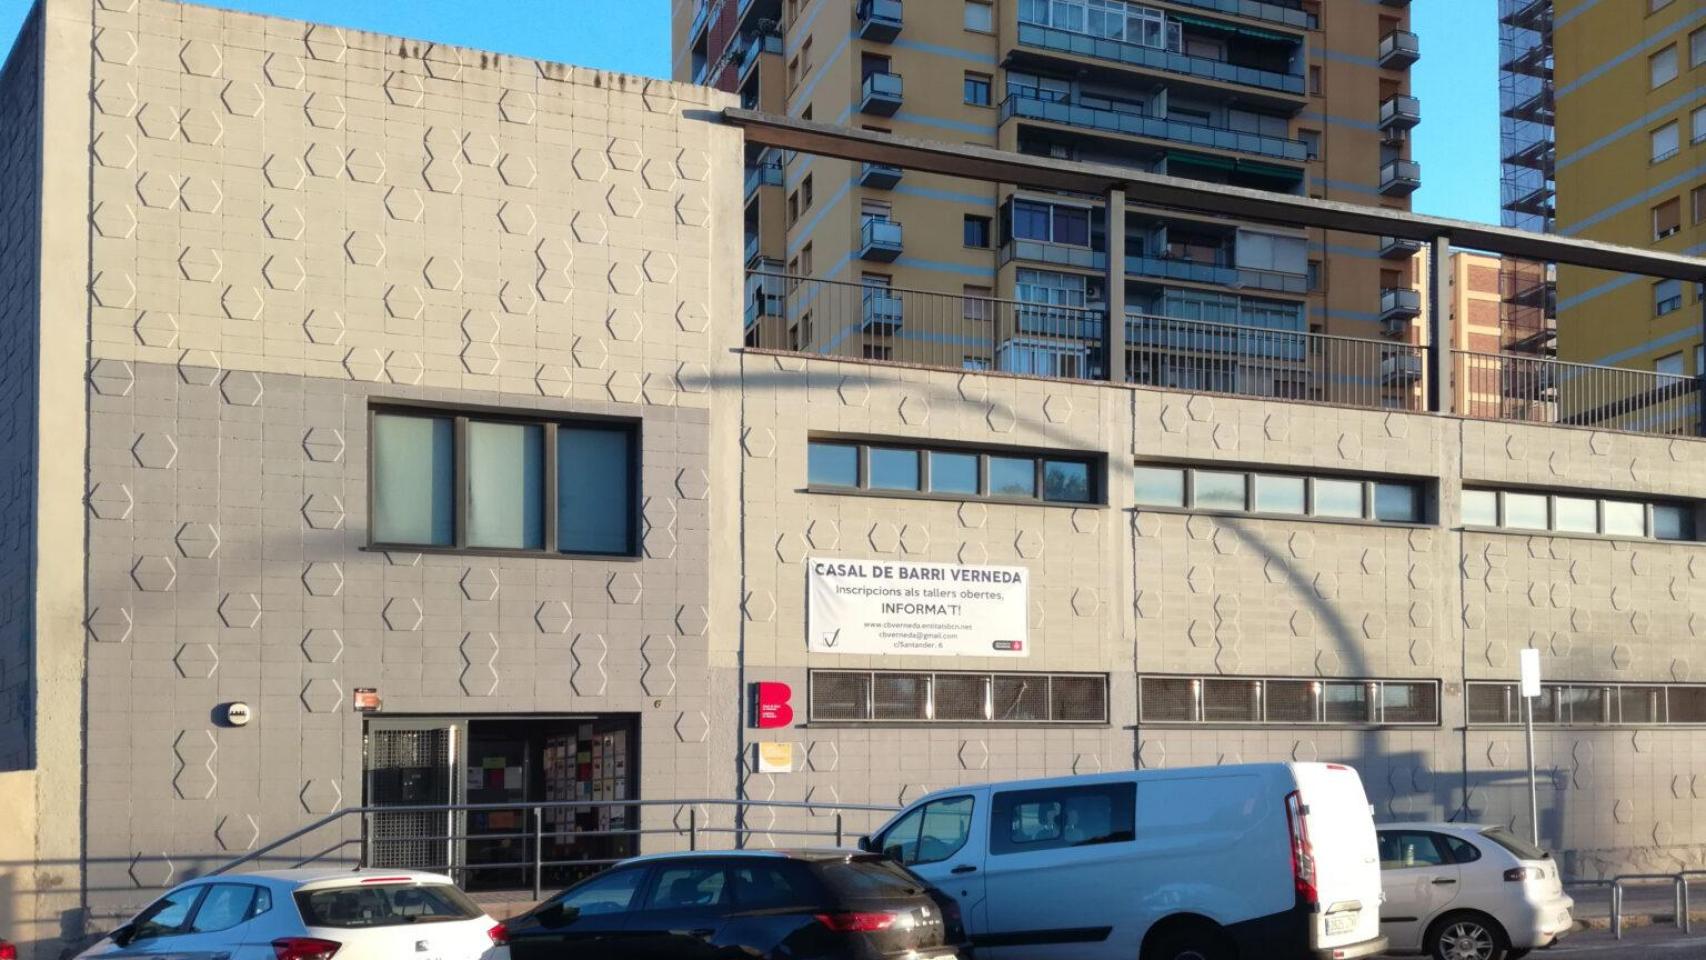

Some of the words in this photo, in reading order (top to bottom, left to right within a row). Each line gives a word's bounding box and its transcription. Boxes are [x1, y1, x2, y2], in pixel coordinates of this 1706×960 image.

[814, 563, 867, 578] CASAL
[873, 566, 893, 579] DE
[899, 567, 945, 581] BARRI
[951, 568, 1022, 583] VERNEDA
[836, 584, 902, 596] Inscripcions
[905, 588, 920, 596] als
[923, 588, 956, 597] tallers
[960, 590, 1004, 600] obertes,
